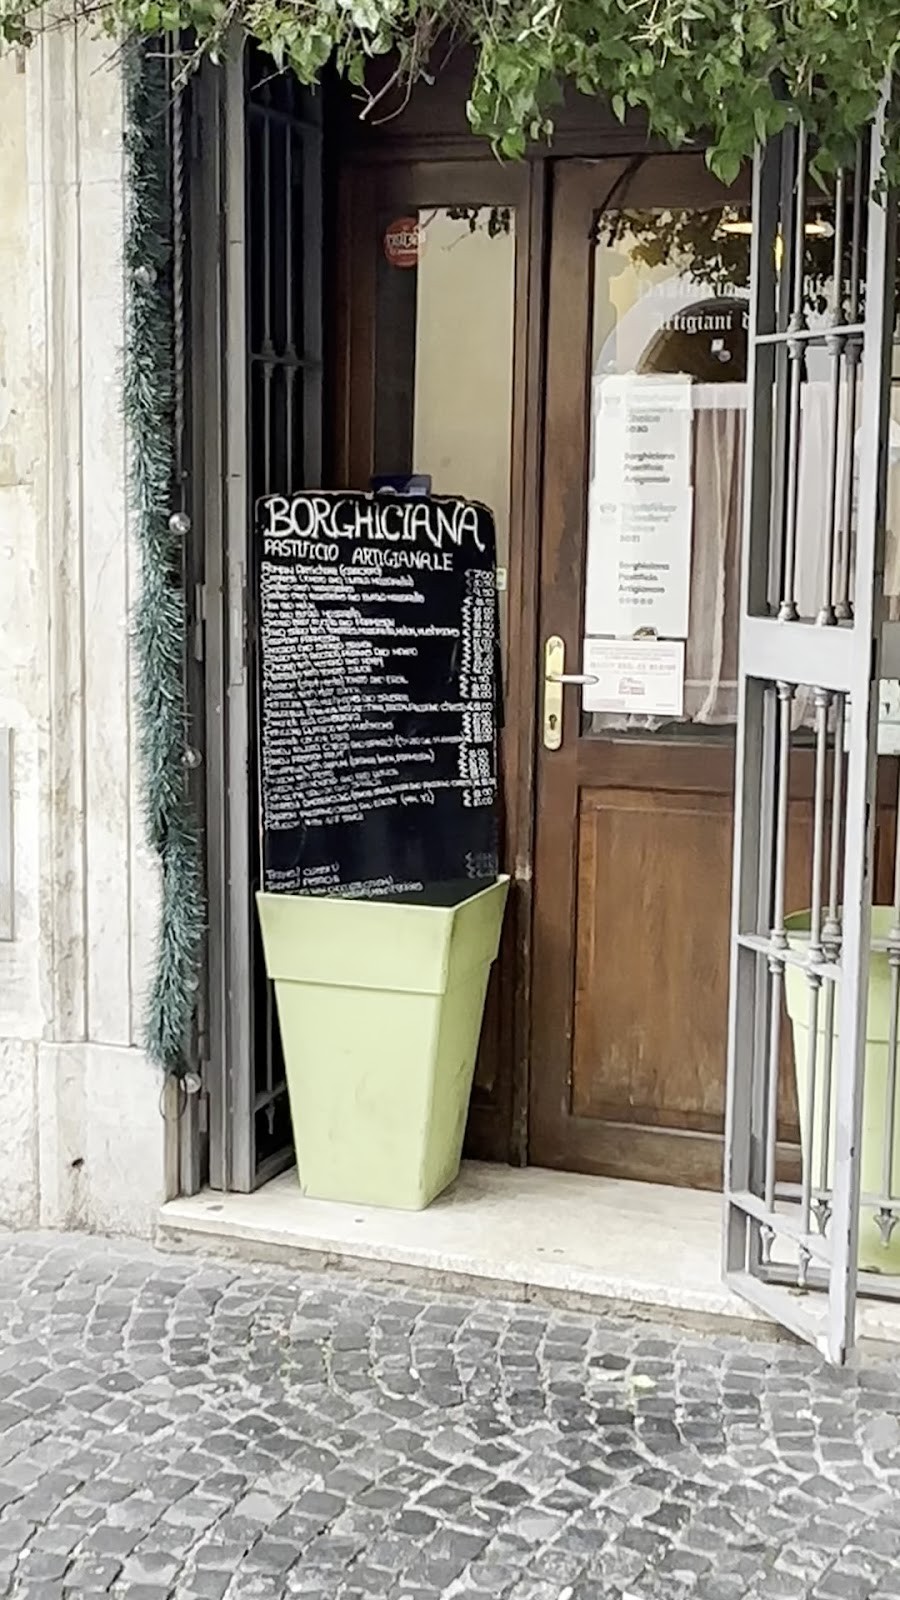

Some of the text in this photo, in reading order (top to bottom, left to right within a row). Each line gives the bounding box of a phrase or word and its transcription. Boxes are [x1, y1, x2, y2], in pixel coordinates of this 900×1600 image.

[264, 497, 485, 552] BORGHICIANA
[264, 539, 453, 571] PASTIFICIO ARTIGIANALE
